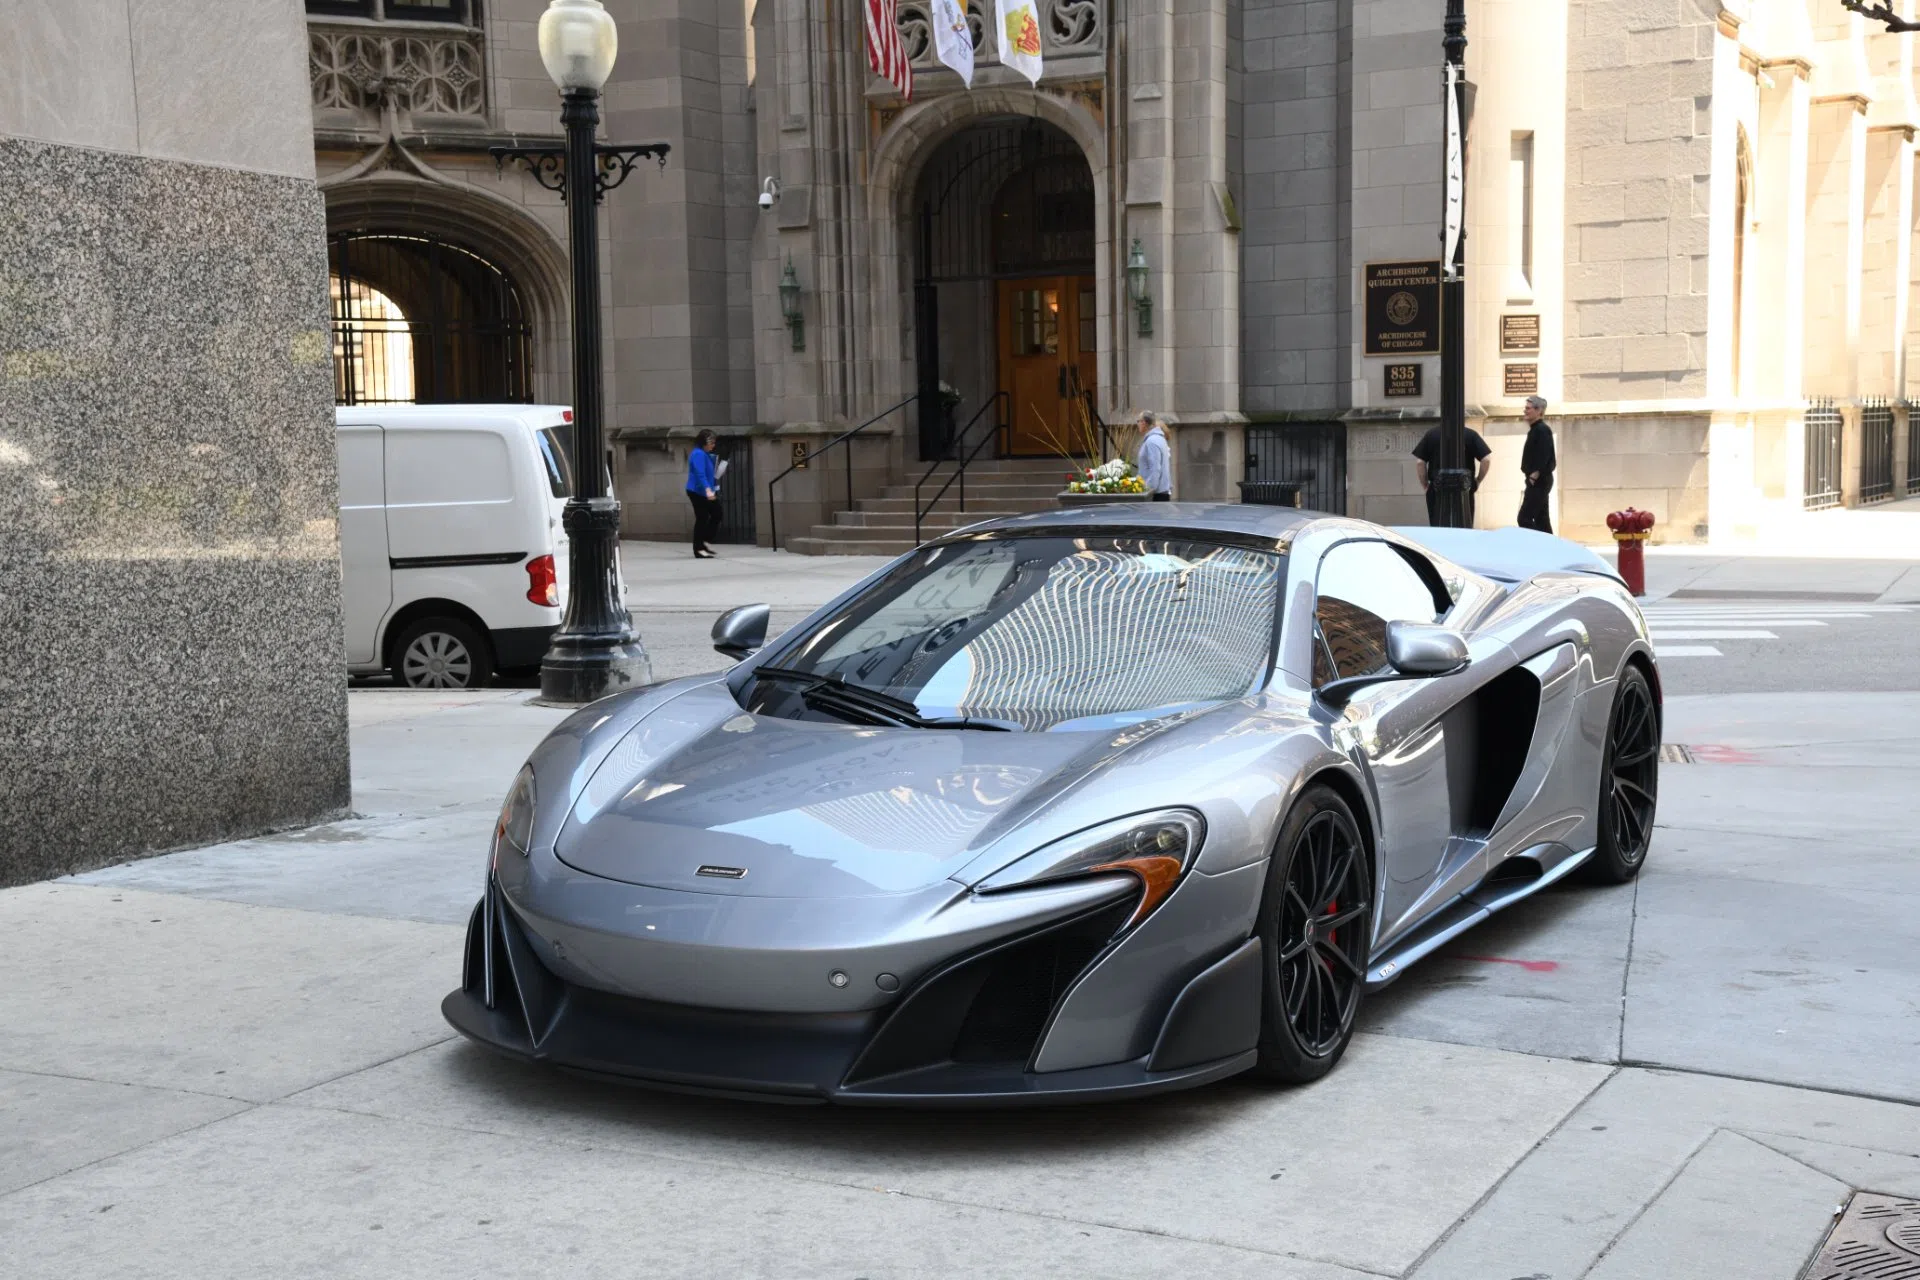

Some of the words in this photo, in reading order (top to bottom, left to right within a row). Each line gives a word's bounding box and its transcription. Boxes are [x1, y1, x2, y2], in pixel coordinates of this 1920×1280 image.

[1376, 266, 1429, 277] ARCHBISHOP
[1368, 277, 1404, 288] QUIGLEY
[1404, 276, 1437, 286] CENTER
[1378, 331, 1427, 340] ARCHDIOCESE
[1392, 340, 1424, 348] CHICAGO
[1390, 366, 1415, 380] 835
